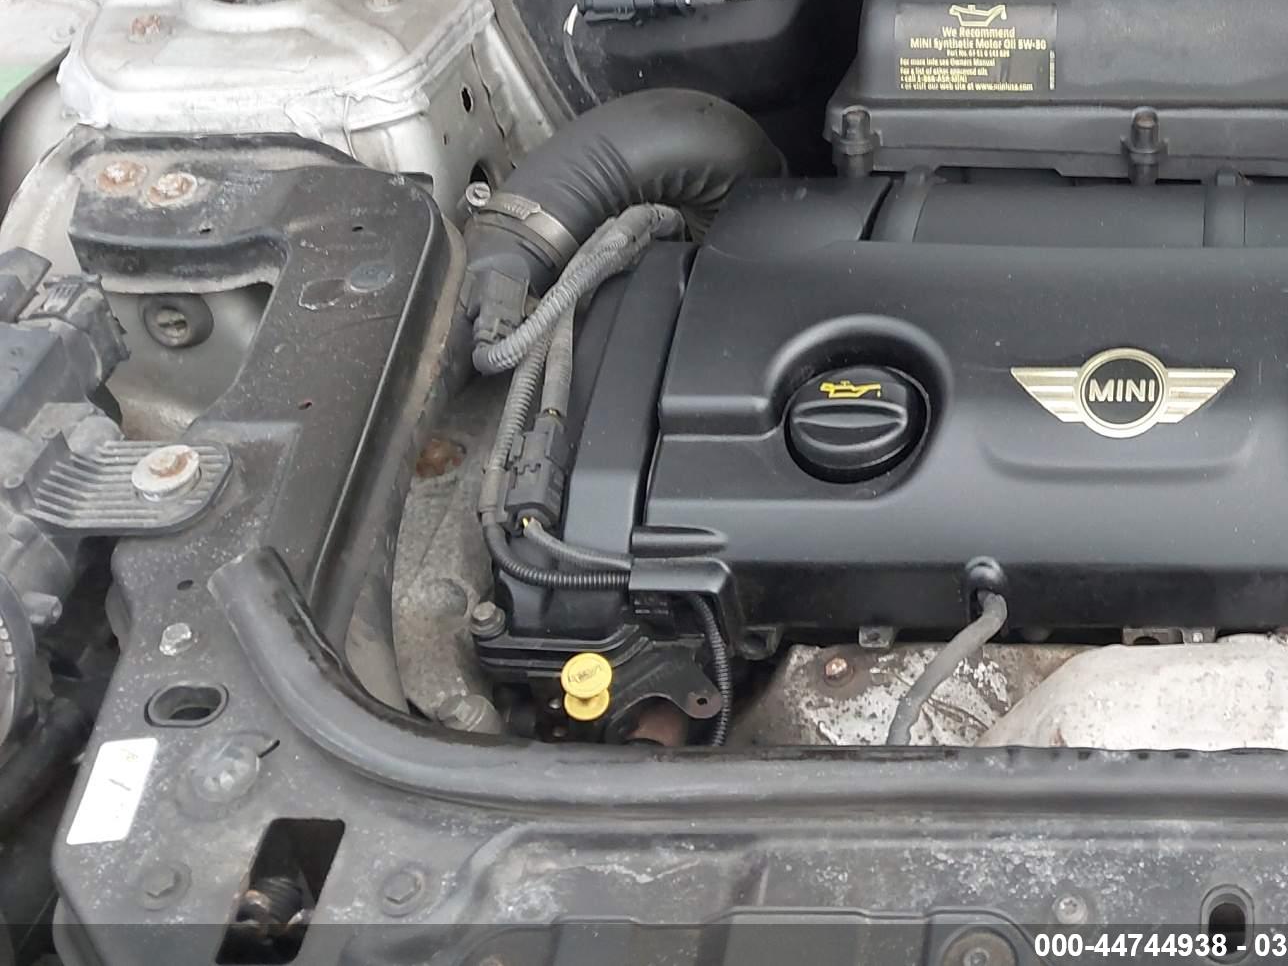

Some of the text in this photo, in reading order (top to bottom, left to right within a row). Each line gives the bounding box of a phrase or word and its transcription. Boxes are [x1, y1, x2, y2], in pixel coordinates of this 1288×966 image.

[942, 26, 1015, 37] We Recommend
[910, 38, 932, 48] MINI
[934, 38, 973, 50] Synthetic
[975, 39, 1002, 49] Motor
[1004, 39, 1016, 49] Oil
[1088, 379, 1156, 402] MINI
